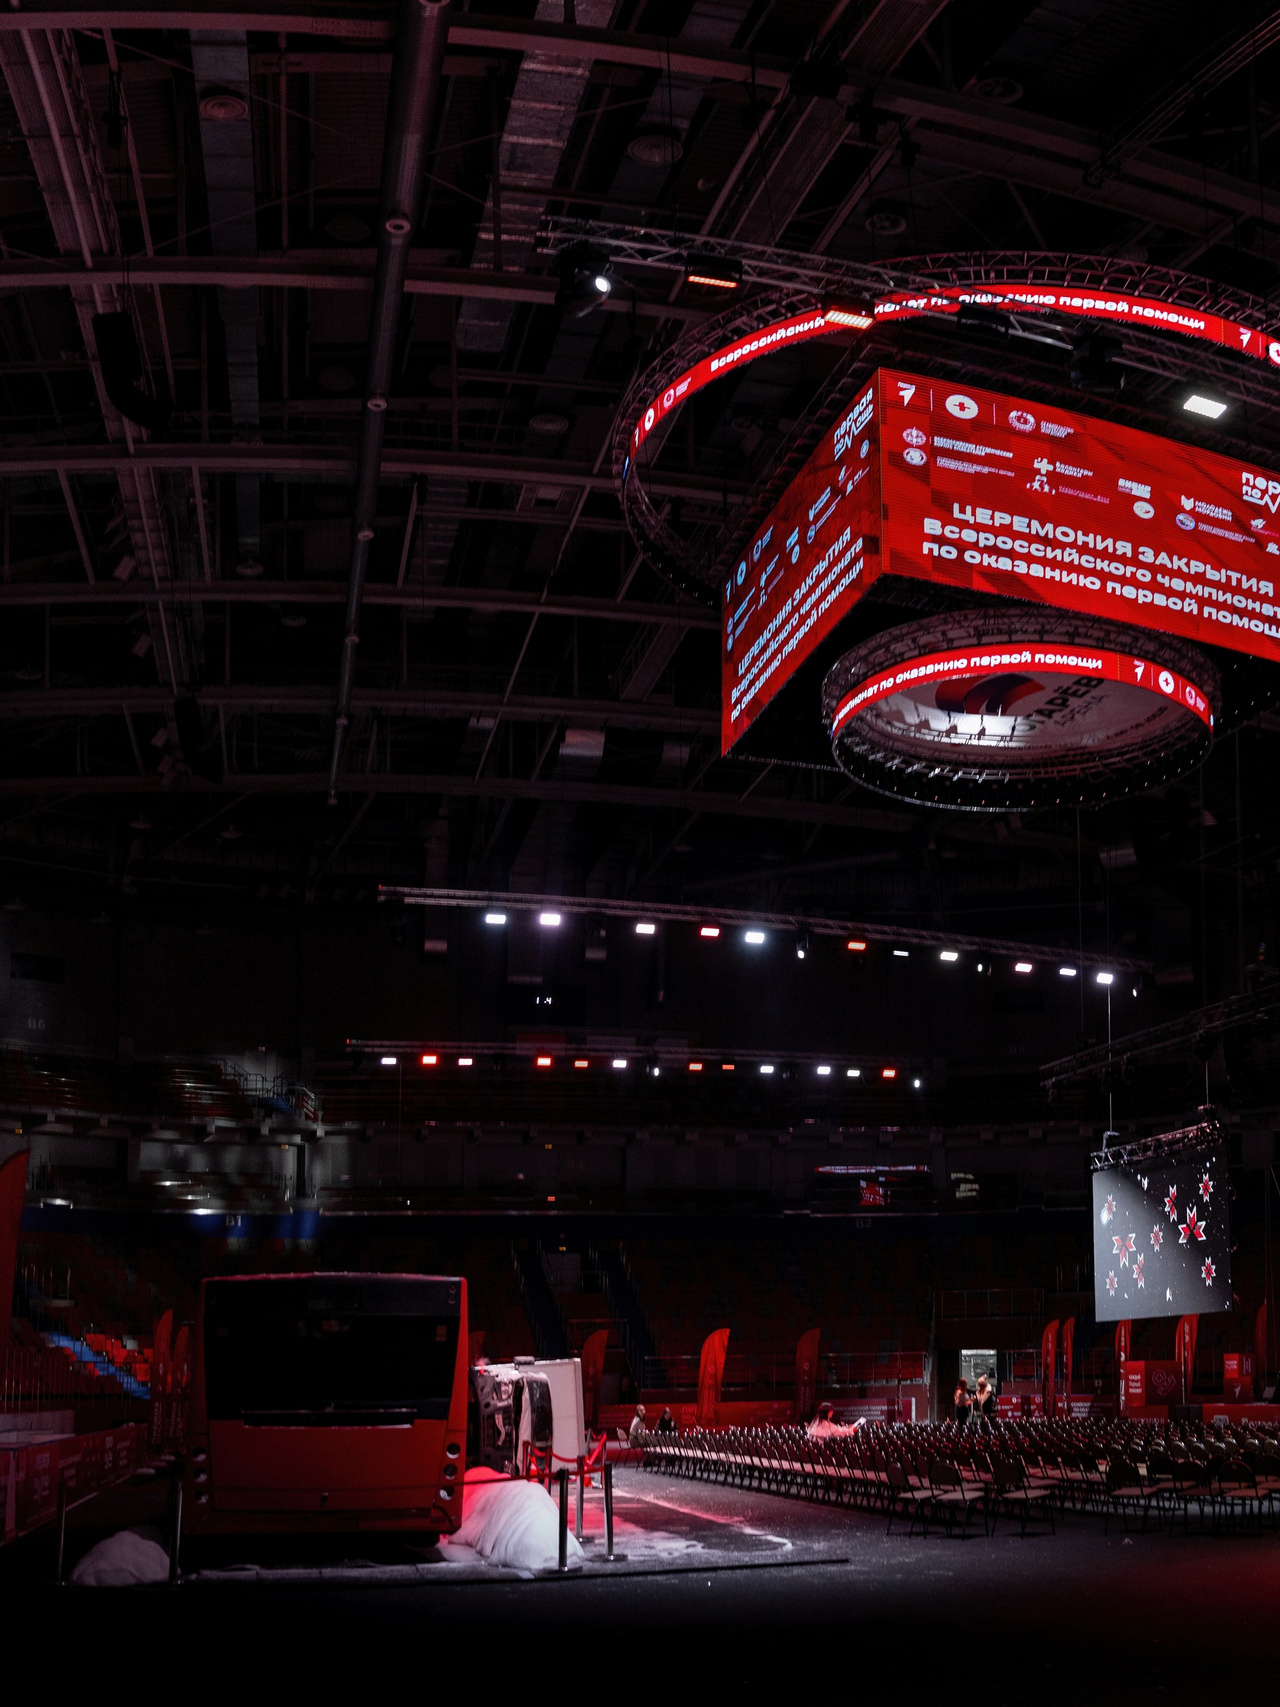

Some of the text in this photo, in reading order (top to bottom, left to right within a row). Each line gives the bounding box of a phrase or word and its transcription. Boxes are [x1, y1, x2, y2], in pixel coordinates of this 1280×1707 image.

[710, 316, 825, 372] Всероссийский
[1059, 296, 1129, 313] первой
[1131, 305, 1205, 330] помощи
[922, 541, 958, 560] по
[963, 550, 1101, 590] оказанию
[1106, 580, 1198, 615] первой
[923, 517, 1151, 583] Всероссийского
[953, 502, 1274, 597] ЦЕРЕМОНИЯ ЗАКРЫТИЯ
[731, 537, 863, 704] Всероссийского чемпионата
[731, 703, 741, 723] по
[741, 653, 782, 713] оказанию
[782, 607, 818, 660] первой
[818, 556, 864, 618] помощи
[738, 597, 792, 677] ЦЕРЕМОНИЯ
[793, 526, 851, 606] ЗАКРЫТИЯ
[879, 677, 895, 692] по
[895, 658, 968, 684] оказанию
[970, 651, 1032, 667] первой
[1034, 653, 1102, 669] помощи
